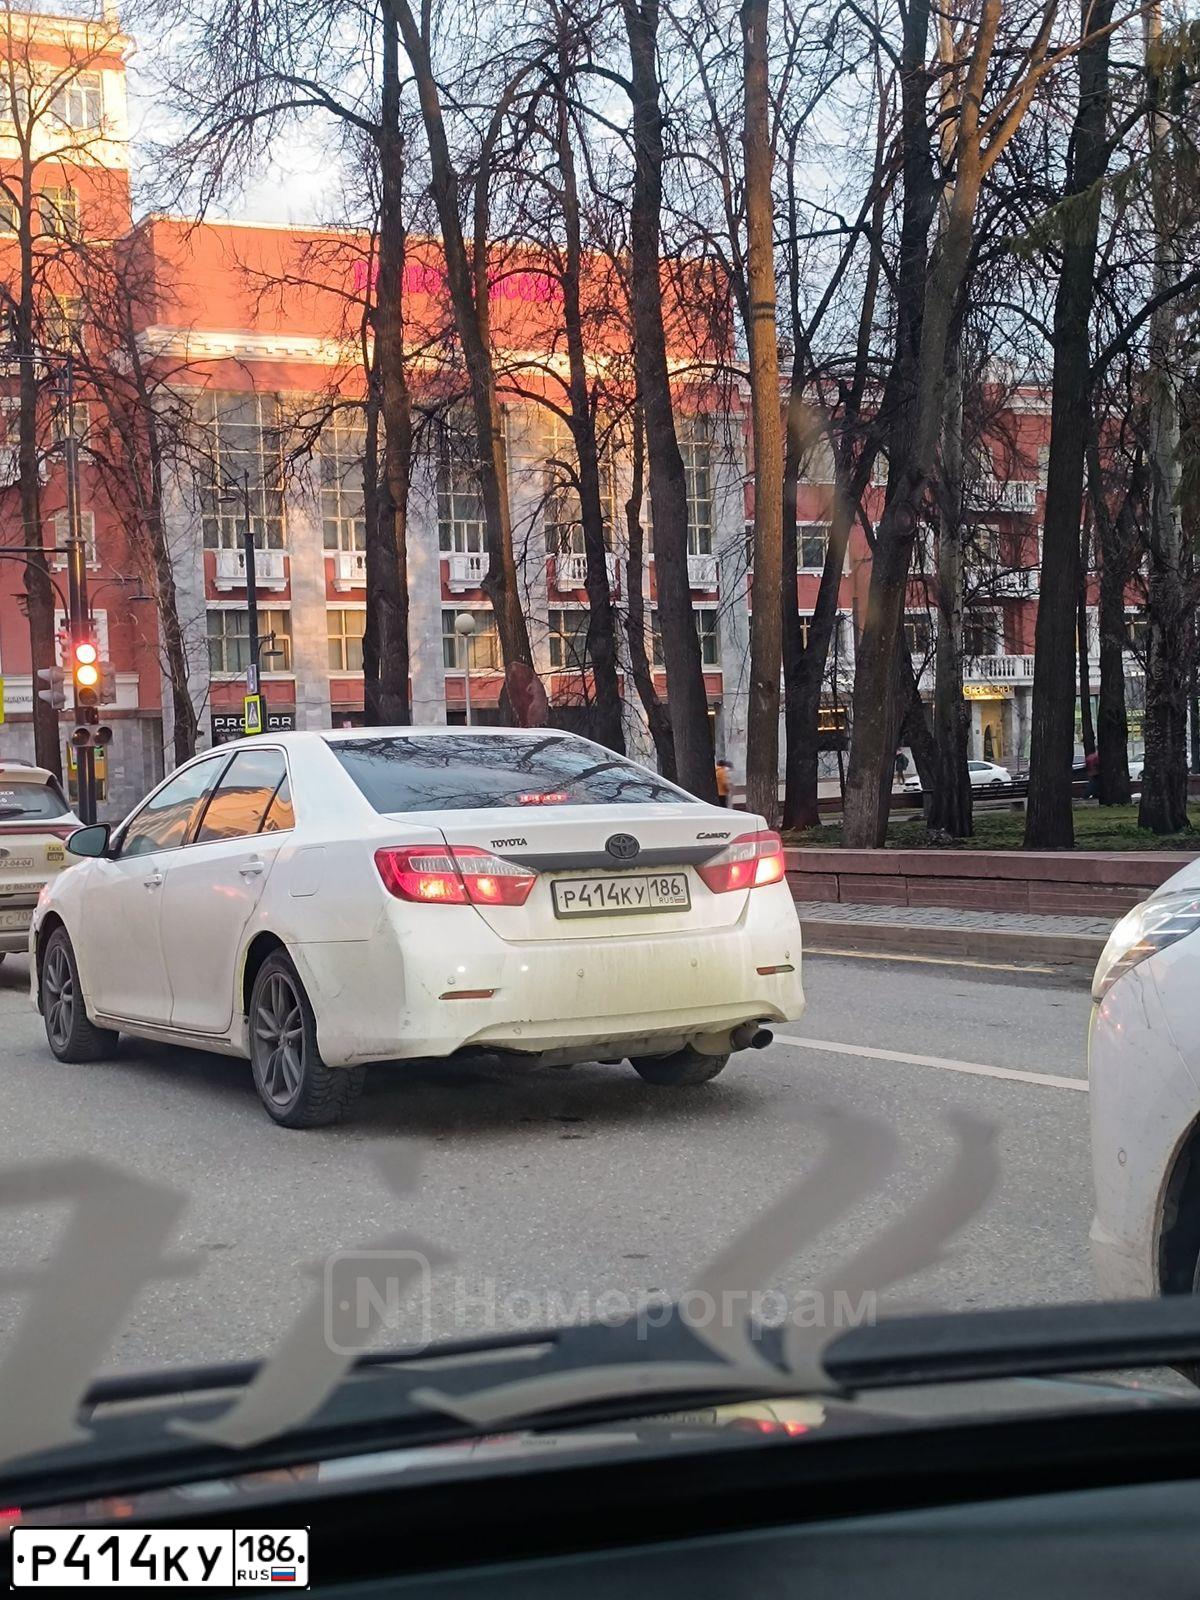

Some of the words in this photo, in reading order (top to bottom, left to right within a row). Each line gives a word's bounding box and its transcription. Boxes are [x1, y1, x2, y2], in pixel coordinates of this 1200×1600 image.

[269, 716, 292, 726] AR
[490, 837, 528, 848] TOYOTA
[563, 882, 645, 909] Р414КУ
[650, 878, 681, 897] 186
